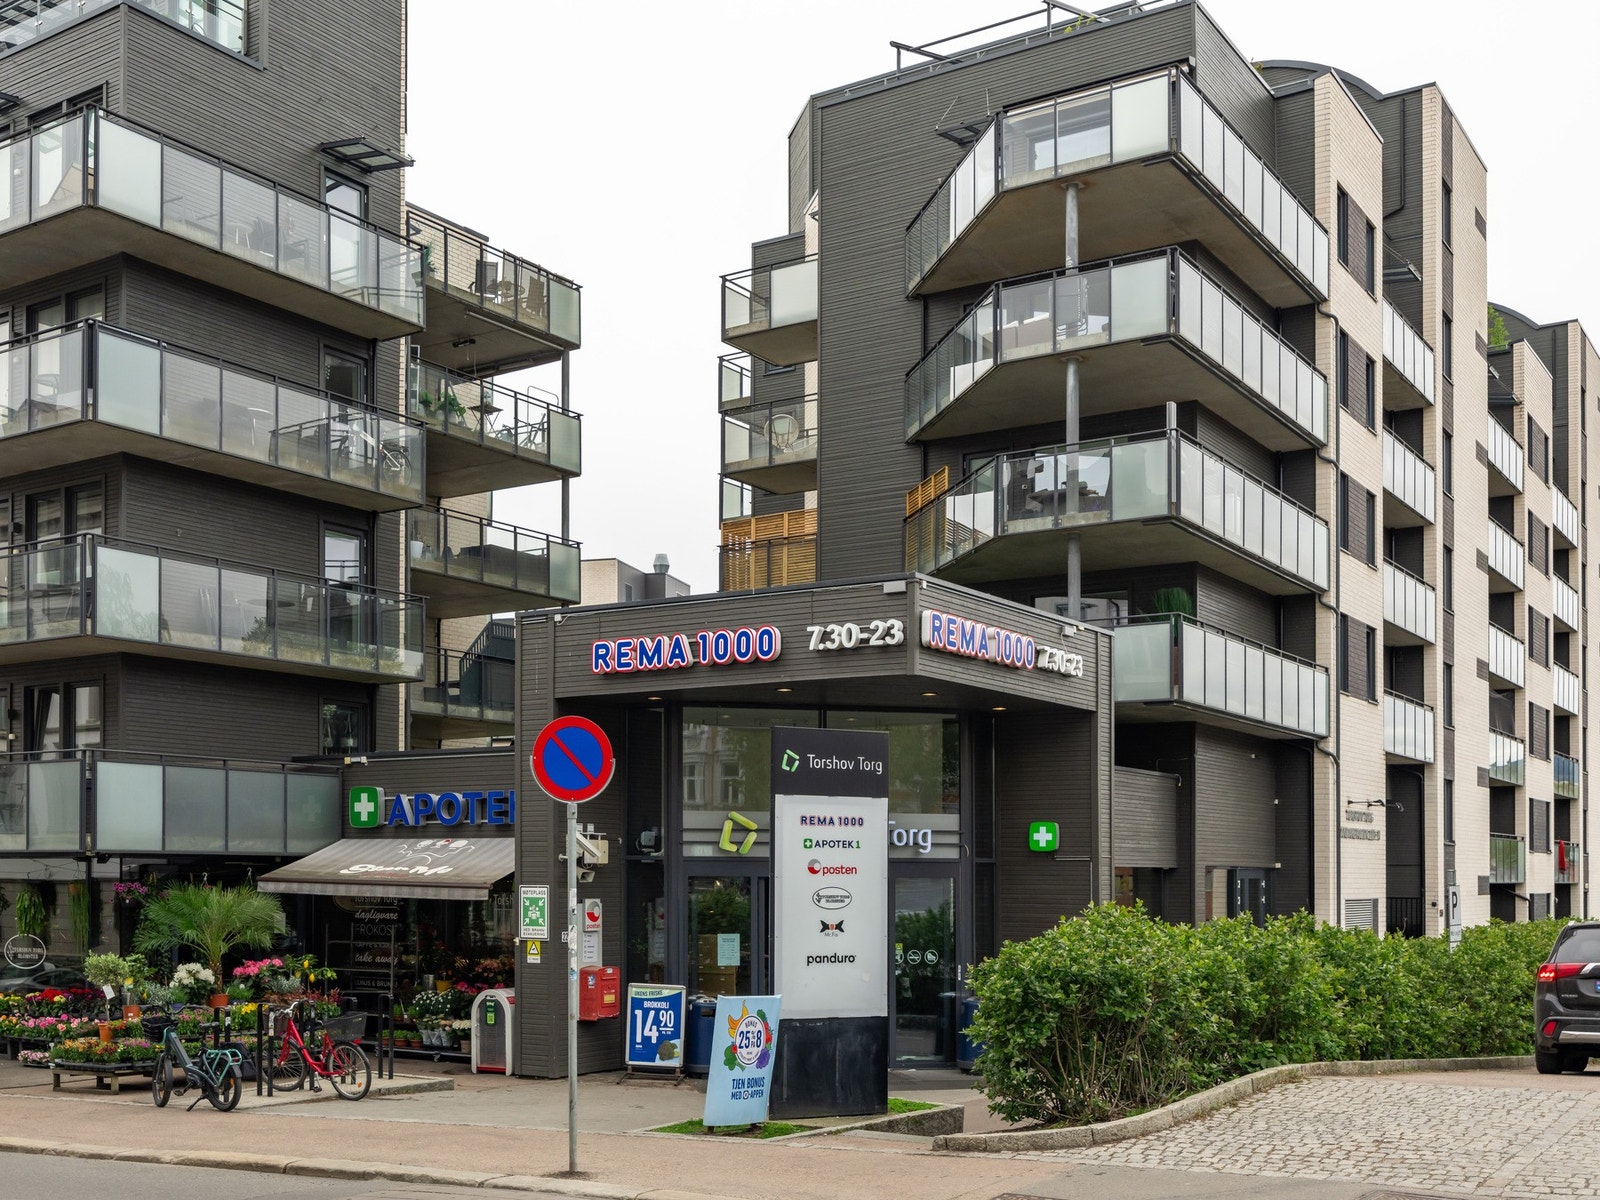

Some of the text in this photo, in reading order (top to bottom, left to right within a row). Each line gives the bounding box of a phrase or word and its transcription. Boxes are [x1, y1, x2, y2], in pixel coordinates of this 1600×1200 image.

[807, 619, 904, 650] 7.30-23
[928, 610, 1035, 670] REMA 1000
[593, 625, 780, 674] REMA 1000
[1037, 645, 1083, 677] 7.30-23
[807, 754, 883, 775] Torshov Torg
[800, 815, 864, 827] REMA 1000
[814, 840, 861, 849] APOTEK 1
[822, 865, 857, 876] posten
[1452, 891, 1458, 919] P
[354, 952, 373, 963] take
[807, 953, 855, 966] panduro
[643, 1001, 669, 1009] BROKKOLI
[744, 1020, 757, 1028] BONUS
[738, 1031, 751, 1049] 25
[756, 1030, 762, 1048] 8
[732, 1077, 765, 1089] TJEN BONUS
[731, 1091, 742, 1100] MED
